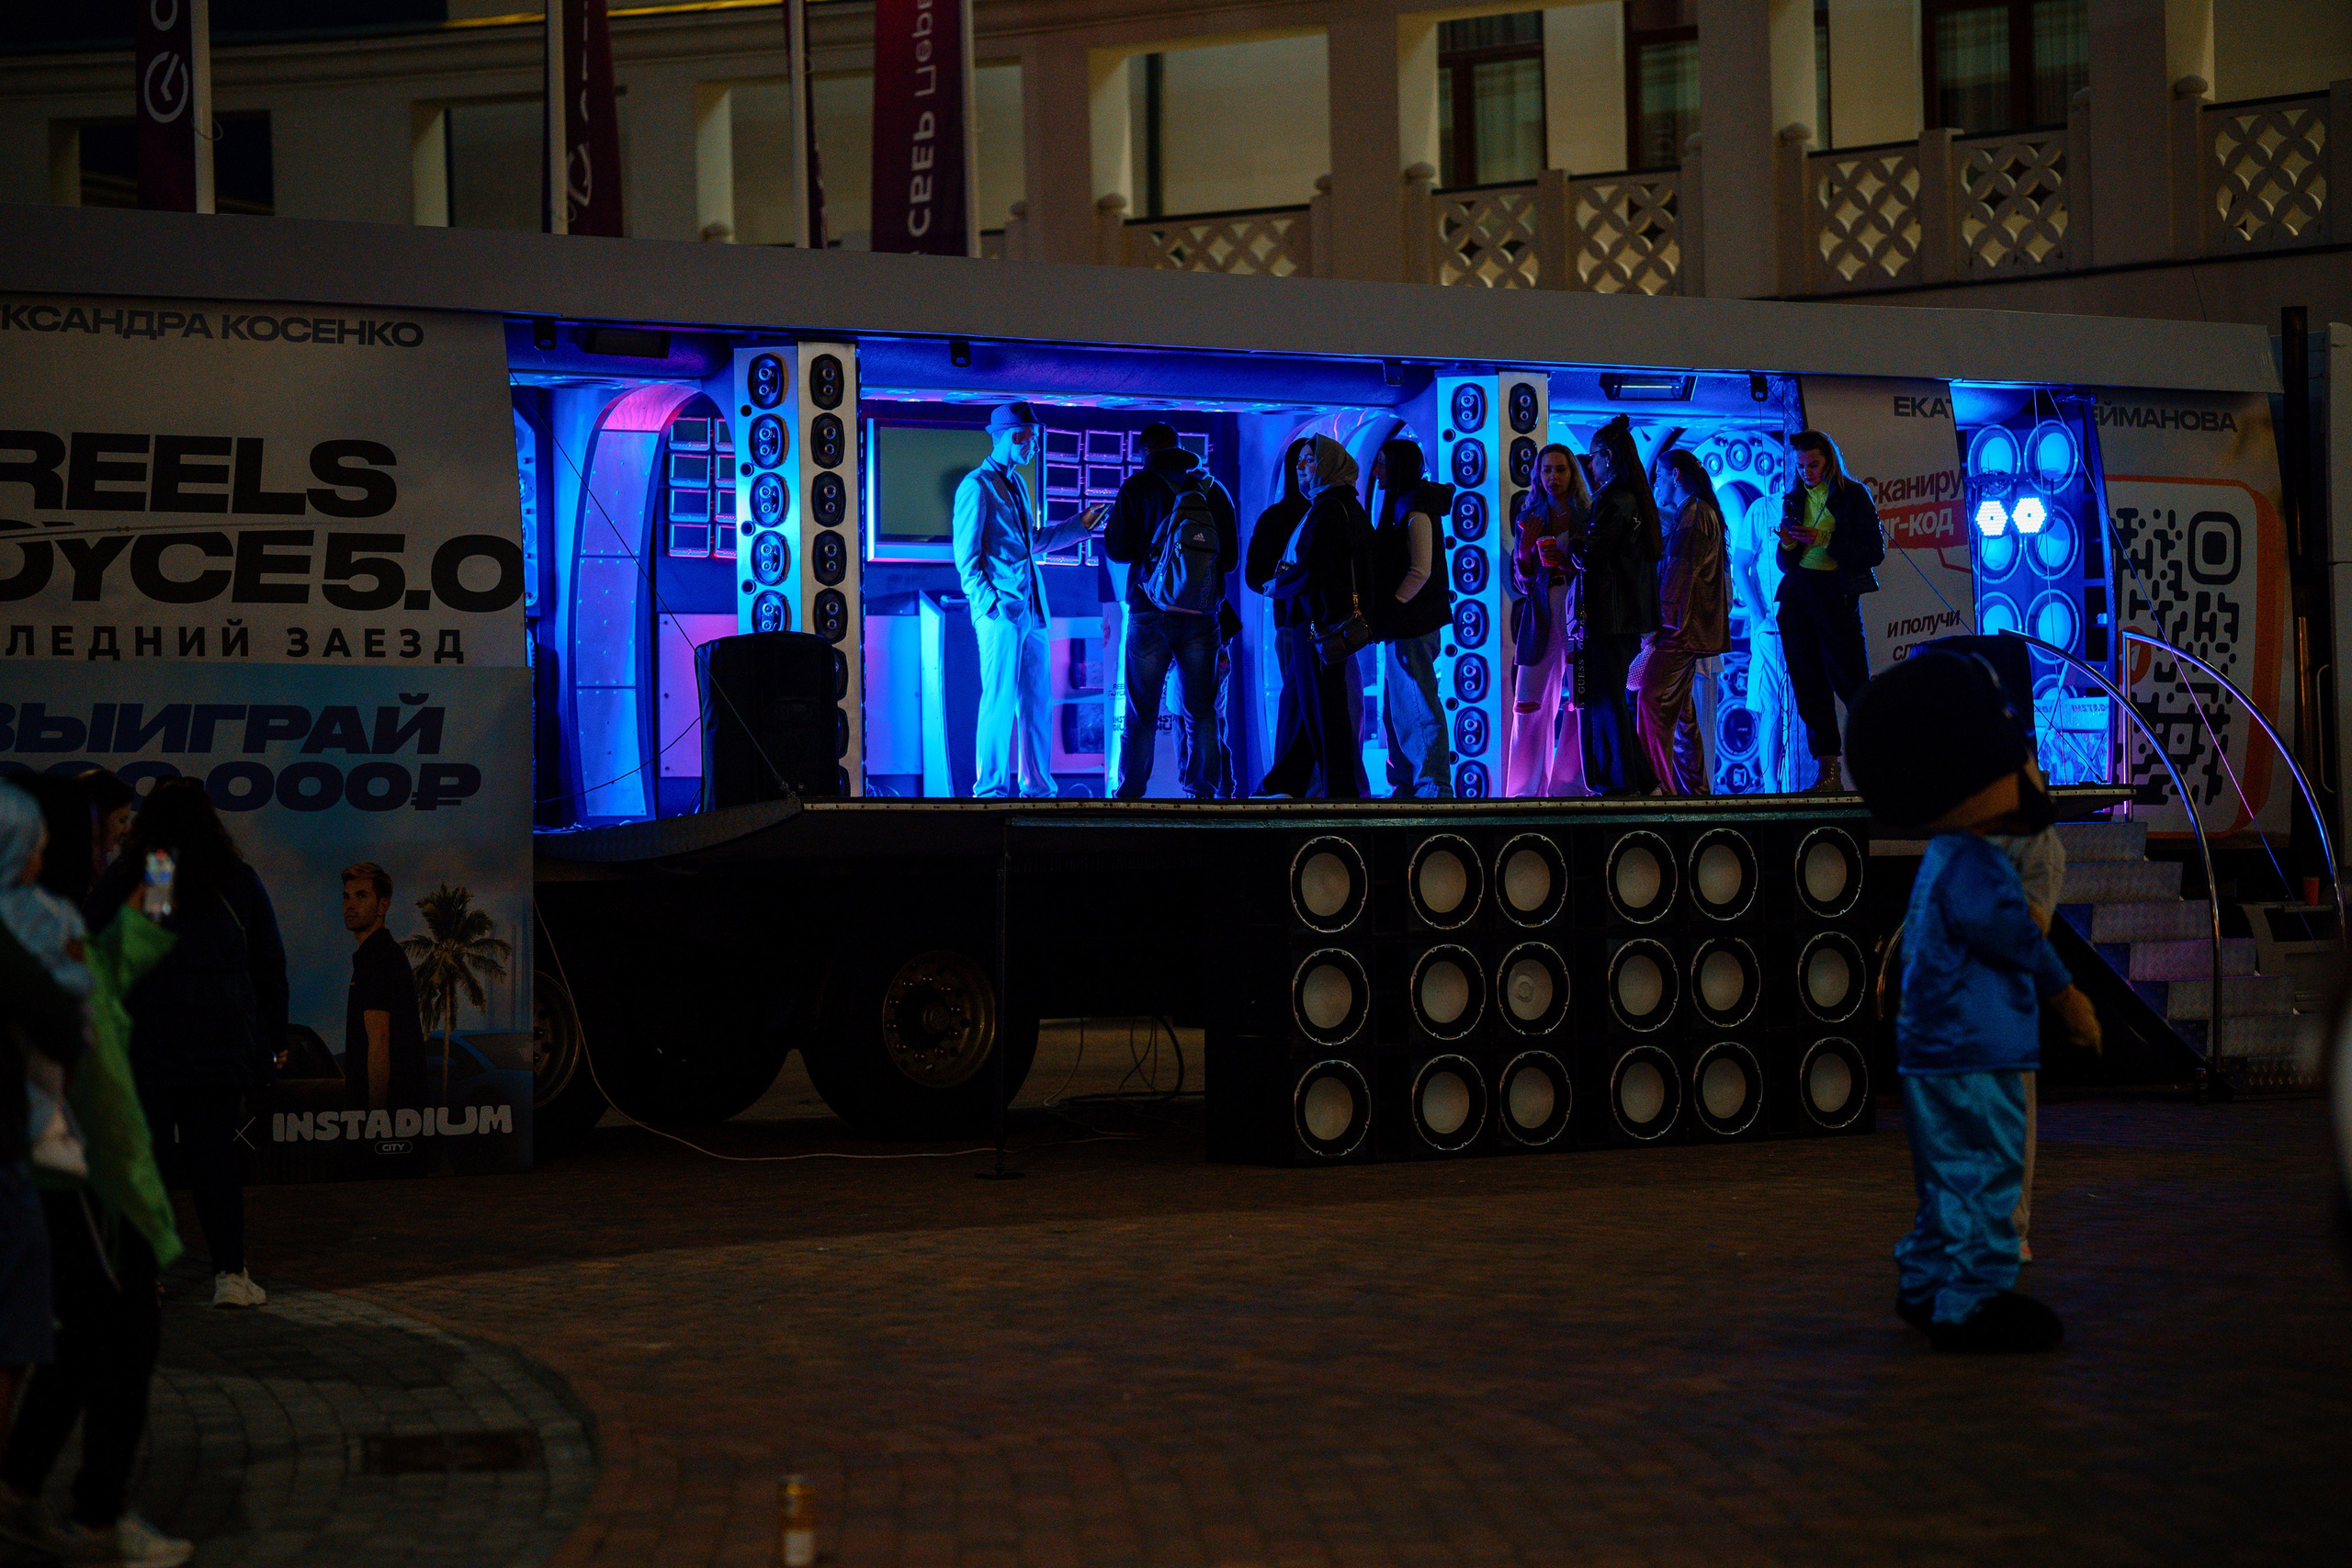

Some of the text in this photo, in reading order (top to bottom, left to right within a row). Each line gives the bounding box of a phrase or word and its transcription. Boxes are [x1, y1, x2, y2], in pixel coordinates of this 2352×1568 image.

[2, 305, 424, 348] КСАНДРА КОСЕНКО
[1894, 396, 1951, 418] ЕКА
[0, 430, 397, 517] REELS
[6, 618, 464, 663] ЛЕДНИЙ ЗАЕЗД
[1900, 610, 1960, 636] получи
[1577, 659, 1586, 694] GUESS
[273, 1104, 514, 1142] INSTADIUM
[381, 1143, 405, 1152] CITY
